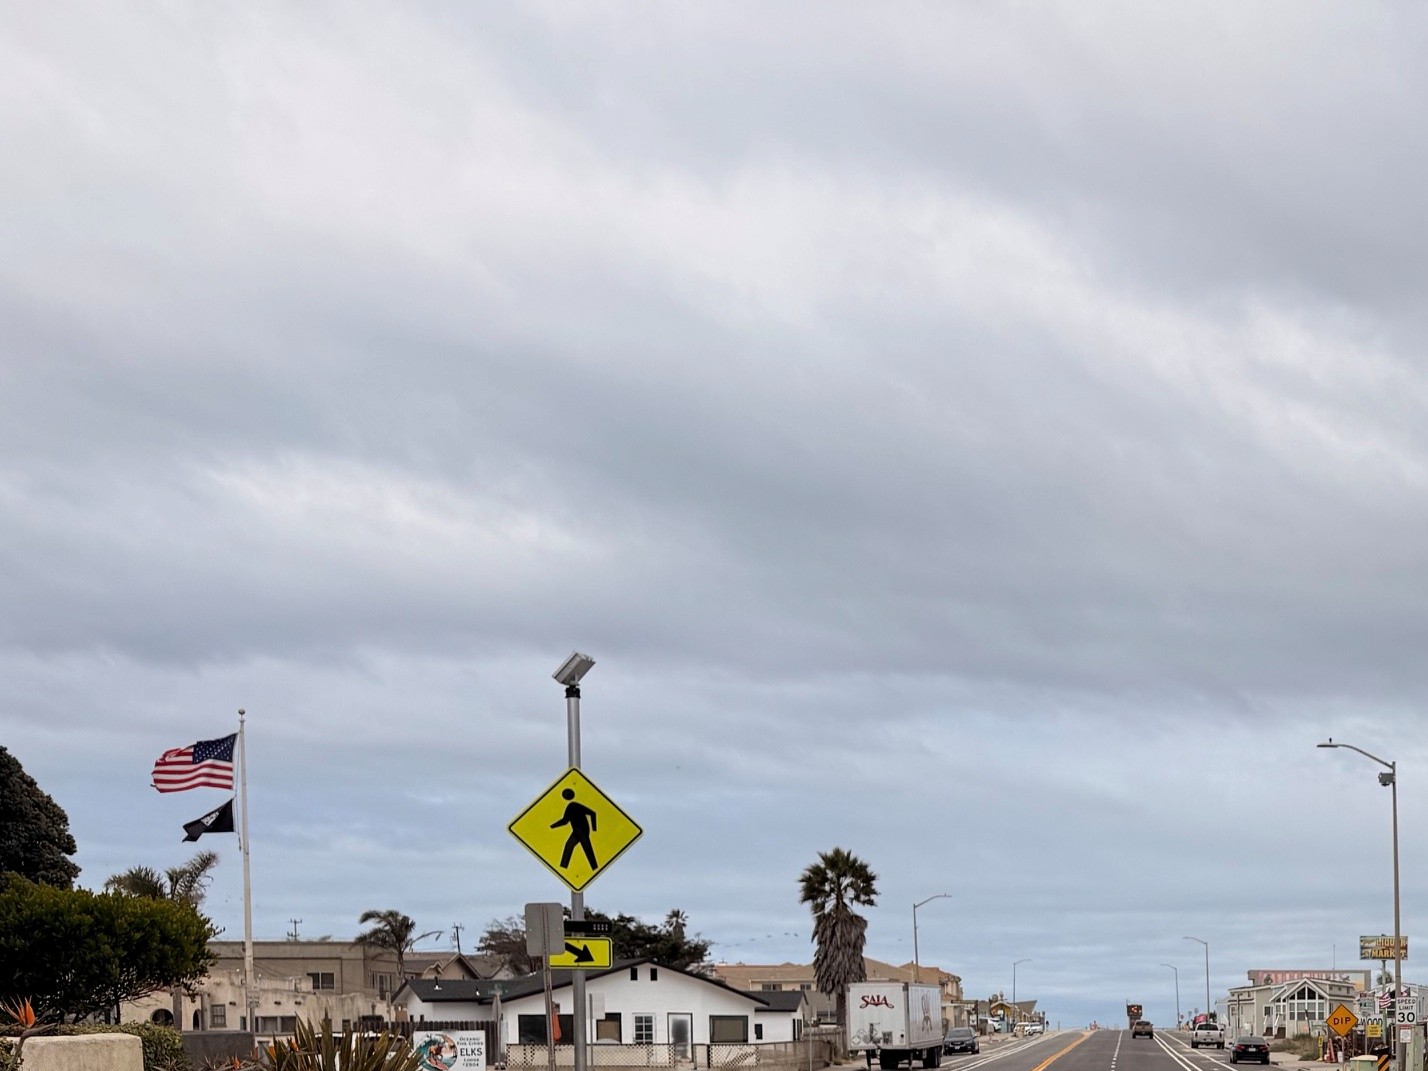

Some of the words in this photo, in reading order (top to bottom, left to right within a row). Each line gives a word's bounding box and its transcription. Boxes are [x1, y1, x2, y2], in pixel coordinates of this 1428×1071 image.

[1376, 937, 1407, 946] LIQUR
[1371, 948, 1406, 958] MARKT
[860, 994, 894, 1009] SAIA
[1333, 1016, 1351, 1025] DIP
[1397, 1012, 1416, 1023] 30
[460, 1047, 483, 1056] ELKS
